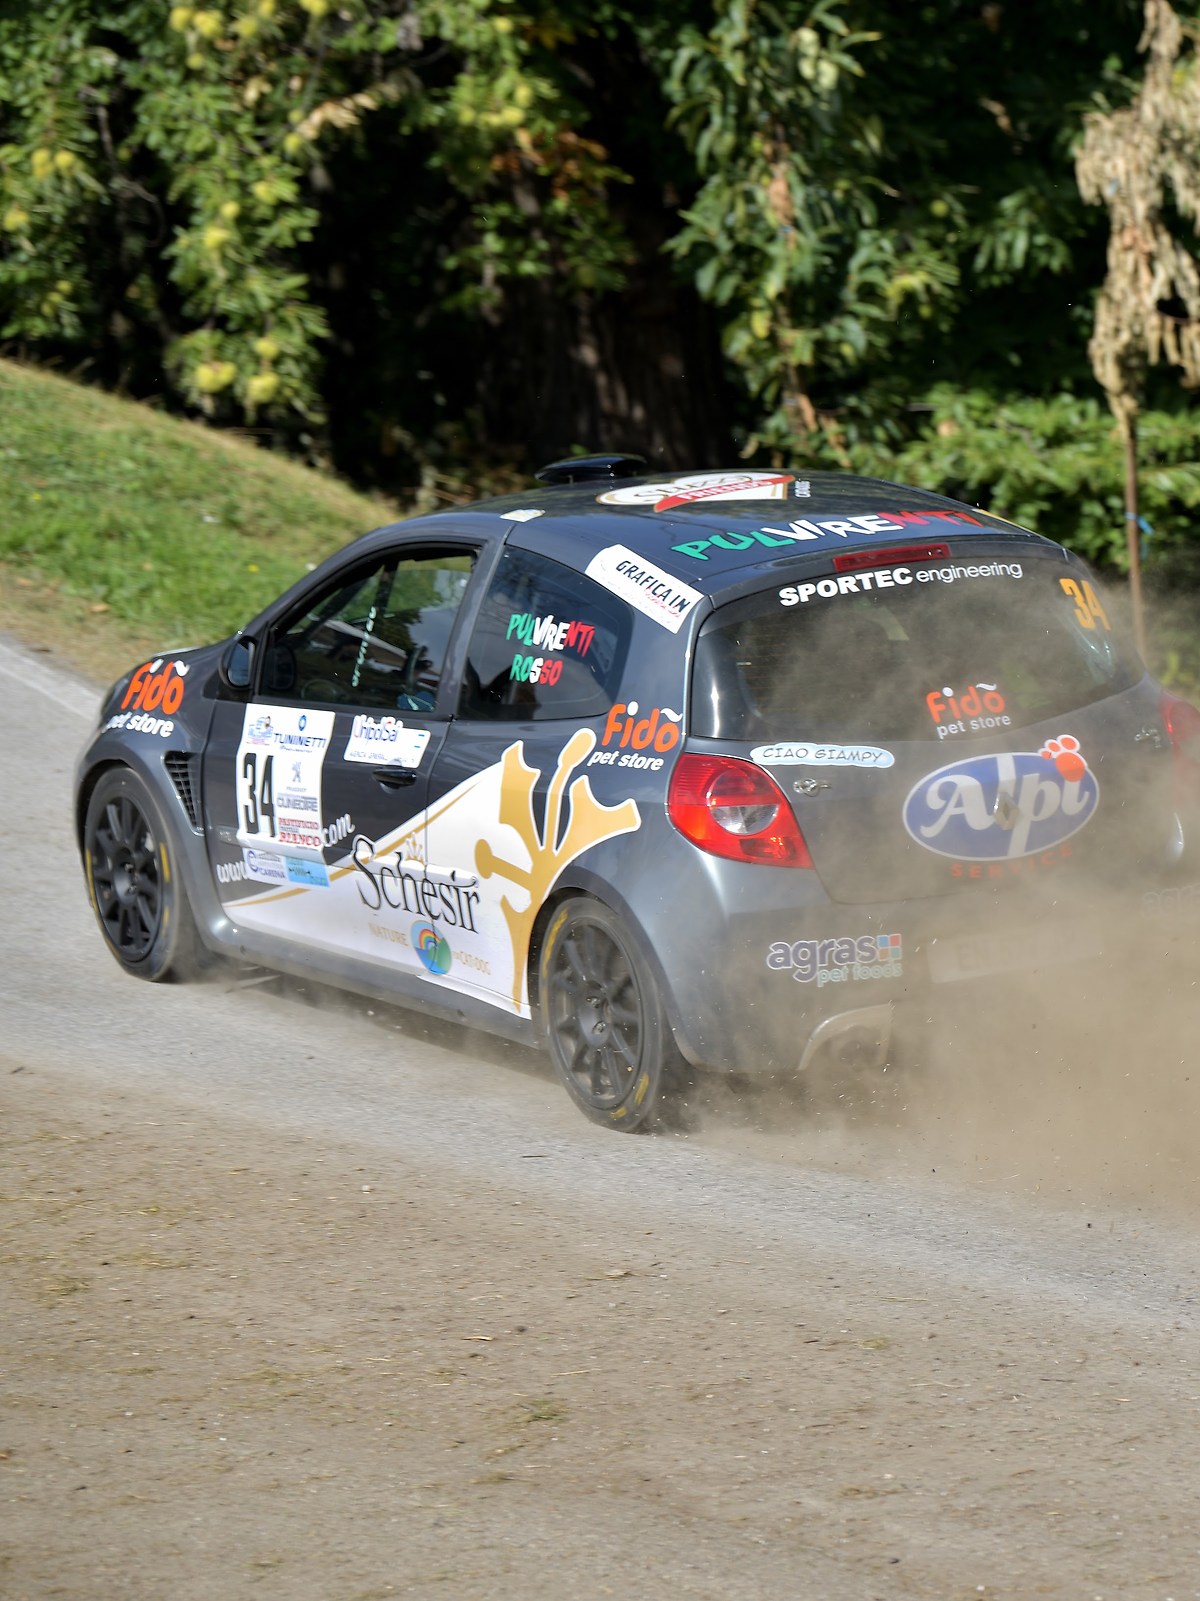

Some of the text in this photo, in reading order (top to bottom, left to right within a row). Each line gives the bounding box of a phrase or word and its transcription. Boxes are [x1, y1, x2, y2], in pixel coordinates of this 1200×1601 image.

[671, 511, 985, 560] PULVIRENTI
[616, 560, 673, 602] GRAFICA
[779, 561, 1023, 607] SPORTEC engineering
[1059, 578, 1112, 631] 34
[506, 612, 595, 657] PULVIRENTI
[509, 654, 563, 686] ROSSO
[126, 713, 174, 738] store
[936, 715, 1012, 740] pet store
[587, 751, 664, 771] pet store
[762, 747, 883, 762] CIAO GIAMPY
[243, 752, 276, 838] 34
[919, 753, 1090, 857] Alpi
[950, 846, 1076, 879] SERVICE
[353, 836, 480, 933] Schesir
[766, 935, 878, 983] agras
[816, 962, 902, 988] pet foods
